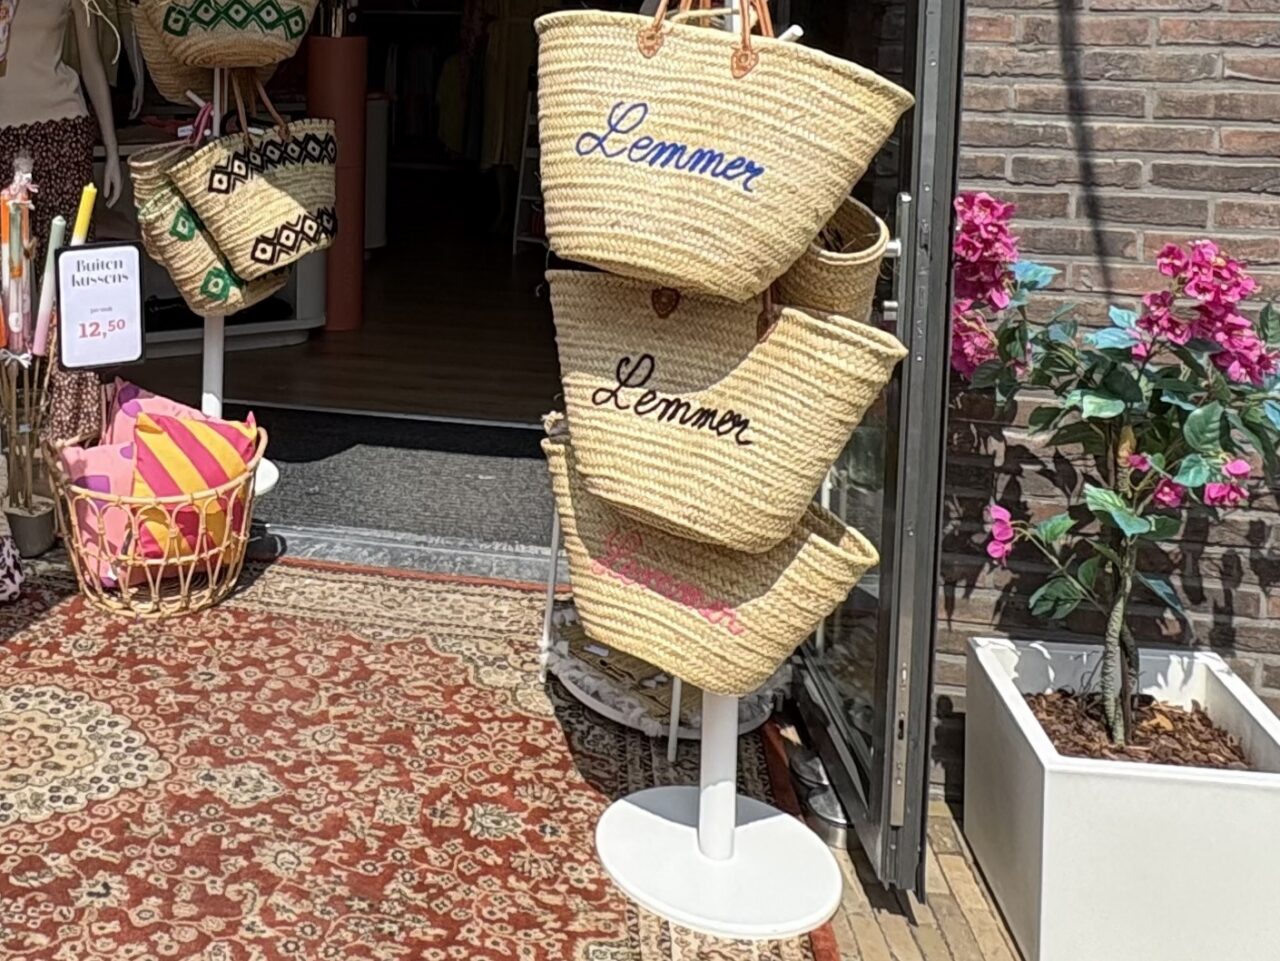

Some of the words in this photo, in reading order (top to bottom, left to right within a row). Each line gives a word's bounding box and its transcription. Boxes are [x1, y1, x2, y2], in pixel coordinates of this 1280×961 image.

[575, 102, 766, 193] Lemmer
[76, 258, 124, 273] Buiten
[71, 273, 129, 288] kussens
[78, 319, 126, 339] 12,50
[591, 353, 753, 446] Lemmer
